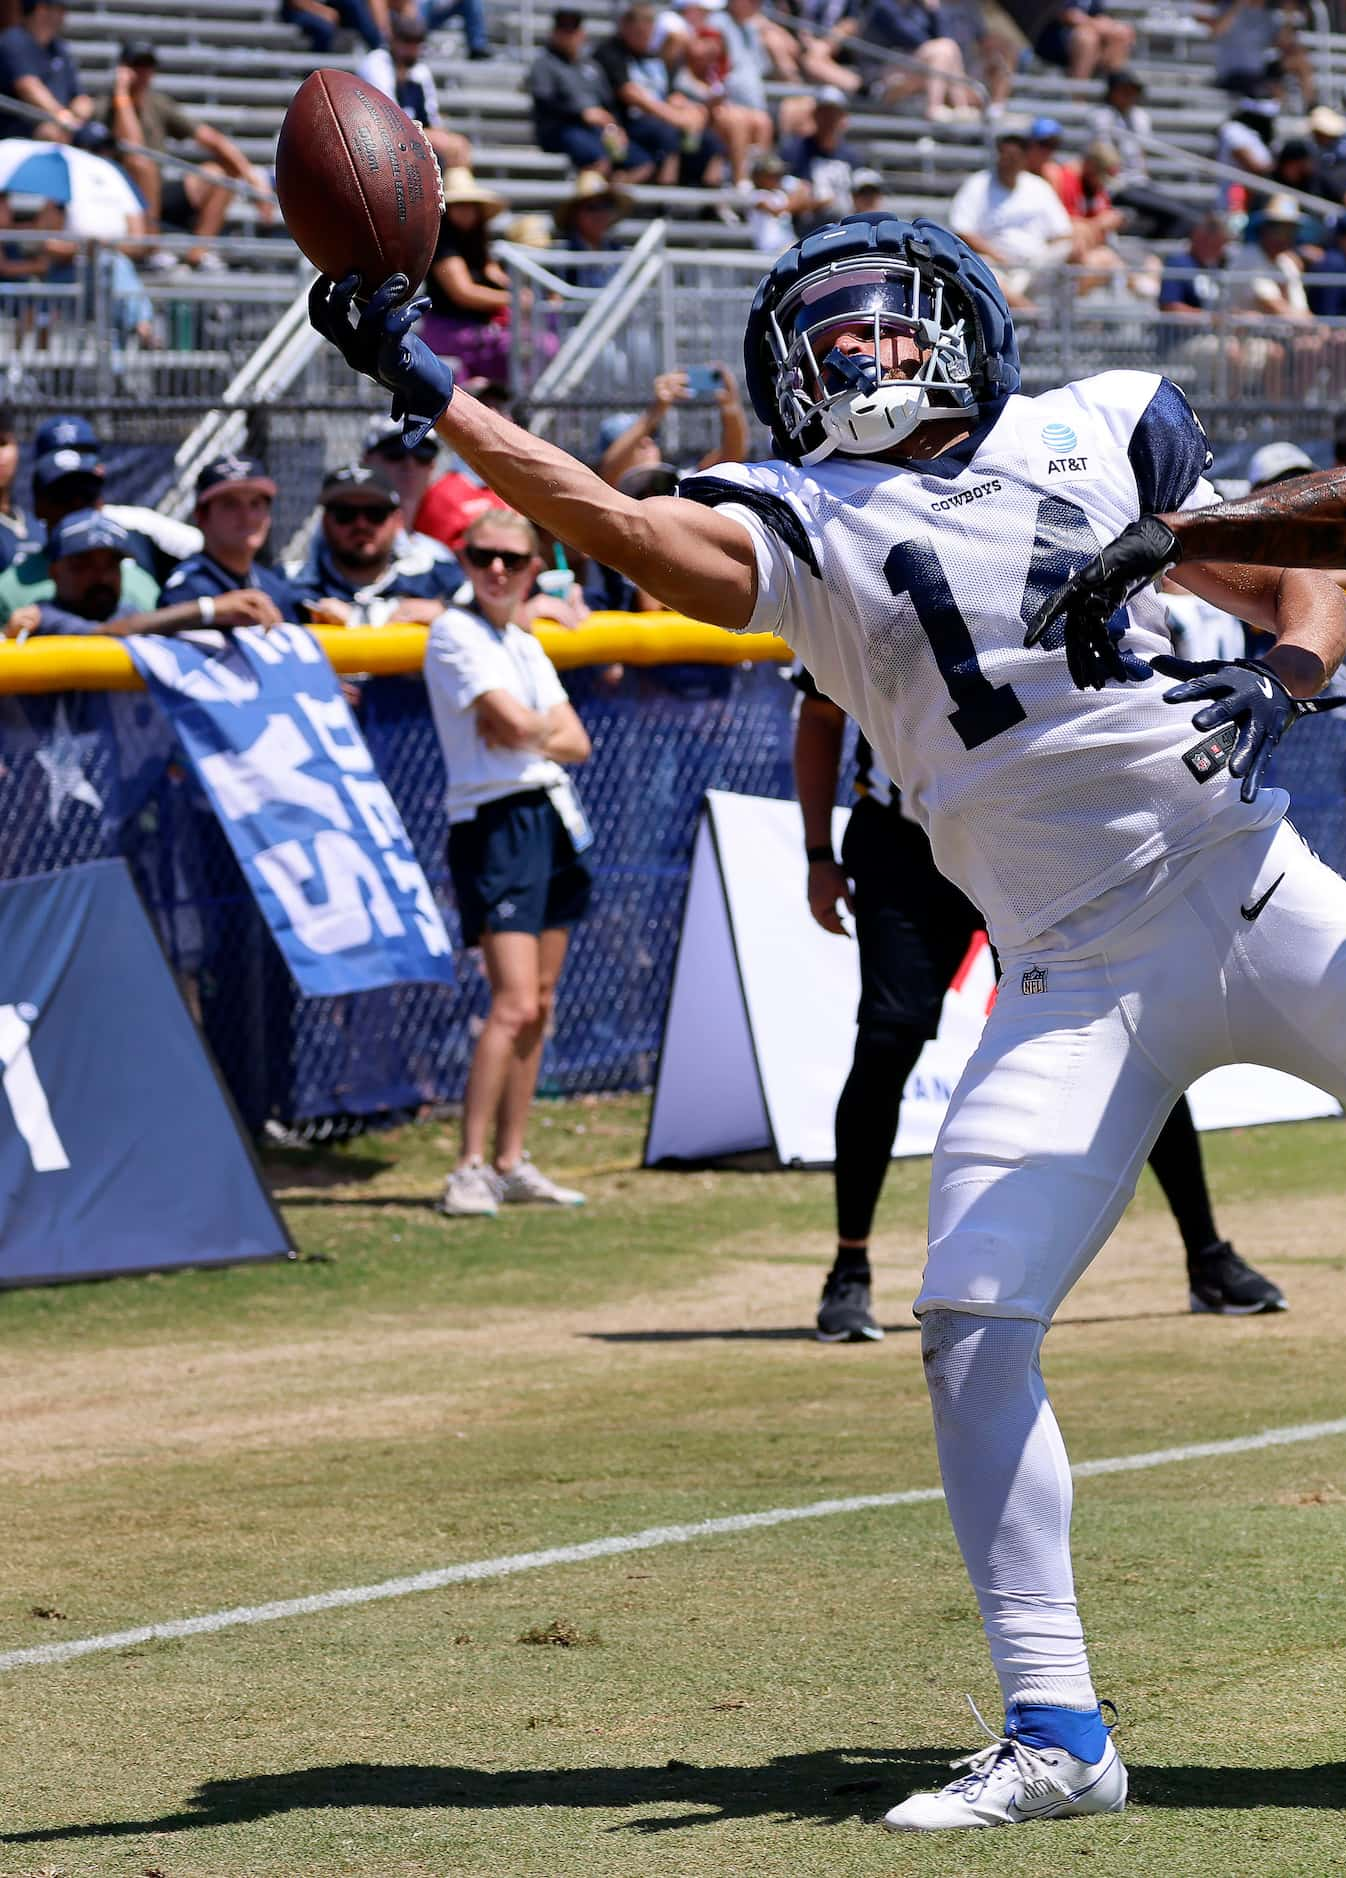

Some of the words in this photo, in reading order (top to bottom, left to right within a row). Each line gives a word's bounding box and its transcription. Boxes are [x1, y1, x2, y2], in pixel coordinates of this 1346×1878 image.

[394, 180, 407, 225] LEAGUE
[1048, 457, 1088, 475] AT&T
[931, 479, 1002, 512] COWBOYS
